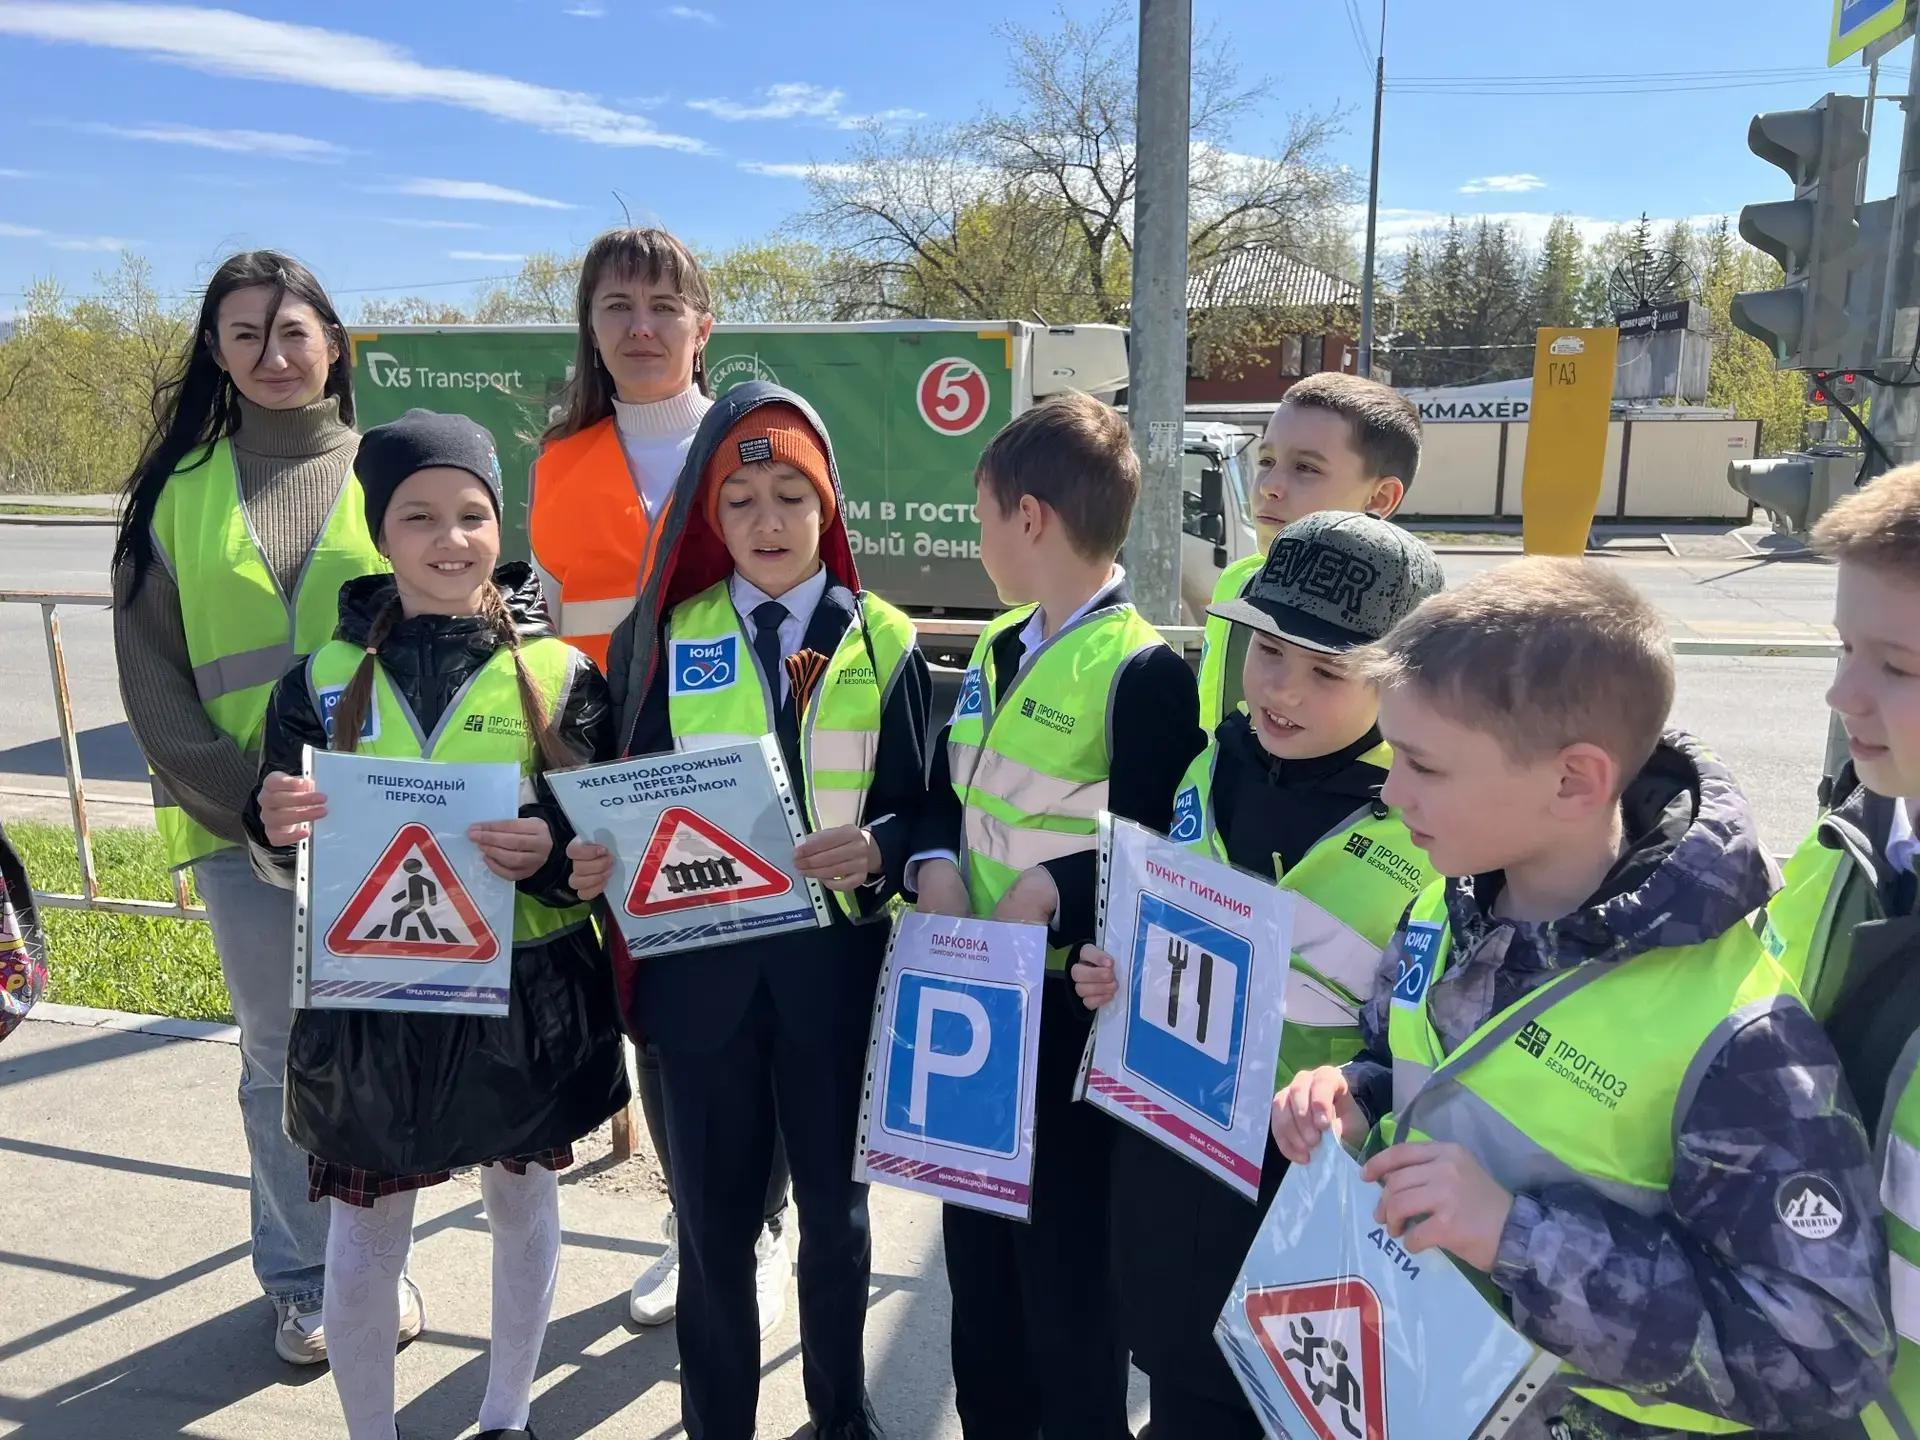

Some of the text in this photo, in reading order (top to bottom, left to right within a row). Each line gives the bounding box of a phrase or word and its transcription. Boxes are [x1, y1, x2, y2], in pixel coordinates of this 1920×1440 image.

[384, 367, 523, 393] X5 Transport
[1549, 361, 1576, 386] ГАЗ
[740, 439, 768, 448] UNIFORM
[690, 645, 723, 658] ЮИД
[845, 668, 875, 678] ПРОГН
[488, 716, 529, 730] ПРОГНО
[1034, 714, 1072, 735] БЕЗОПАСНОСТИ
[1036, 703, 1076, 728] ПРОГНОЗ
[576, 752, 742, 790] ЖЕЛЕЗНОДОРОЖНЫЙ
[367, 774, 466, 791] ПЕШЕХОДНЫЙ
[600, 778, 737, 808] СО ШЛАГБАУМОМ
[633, 774, 696, 792] ПЕРЕЕЗД
[385, 791, 447, 806] ПЕРЕХОД
[1366, 856, 1418, 895] БЕЗОПАСНОСТИ
[1145, 860, 1252, 919] ПУНКТ ПИТАНИЯ
[786, 912, 803, 921] ЗНАК
[931, 933, 989, 952] ПАРКОВКА
[1404, 931, 1432, 952] ЮИД
[405, 988, 477, 998] ПРЕДУПРЕЖДАЮЩИЙ
[1553, 1039, 1629, 1099] ПРОГНОЗ
[1545, 1057, 1619, 1111] БЕЗОПАСНОСТИ
[1189, 1132, 1236, 1167] ЗНАК СЕРВИСА
[938, 1172, 1017, 1196] ИНФОРМАЦИОННЫЙ ЗНАК
[1791, 1217, 1838, 1228] MOUNTAIN
[1367, 1227, 1421, 1281] ДЕТИ
